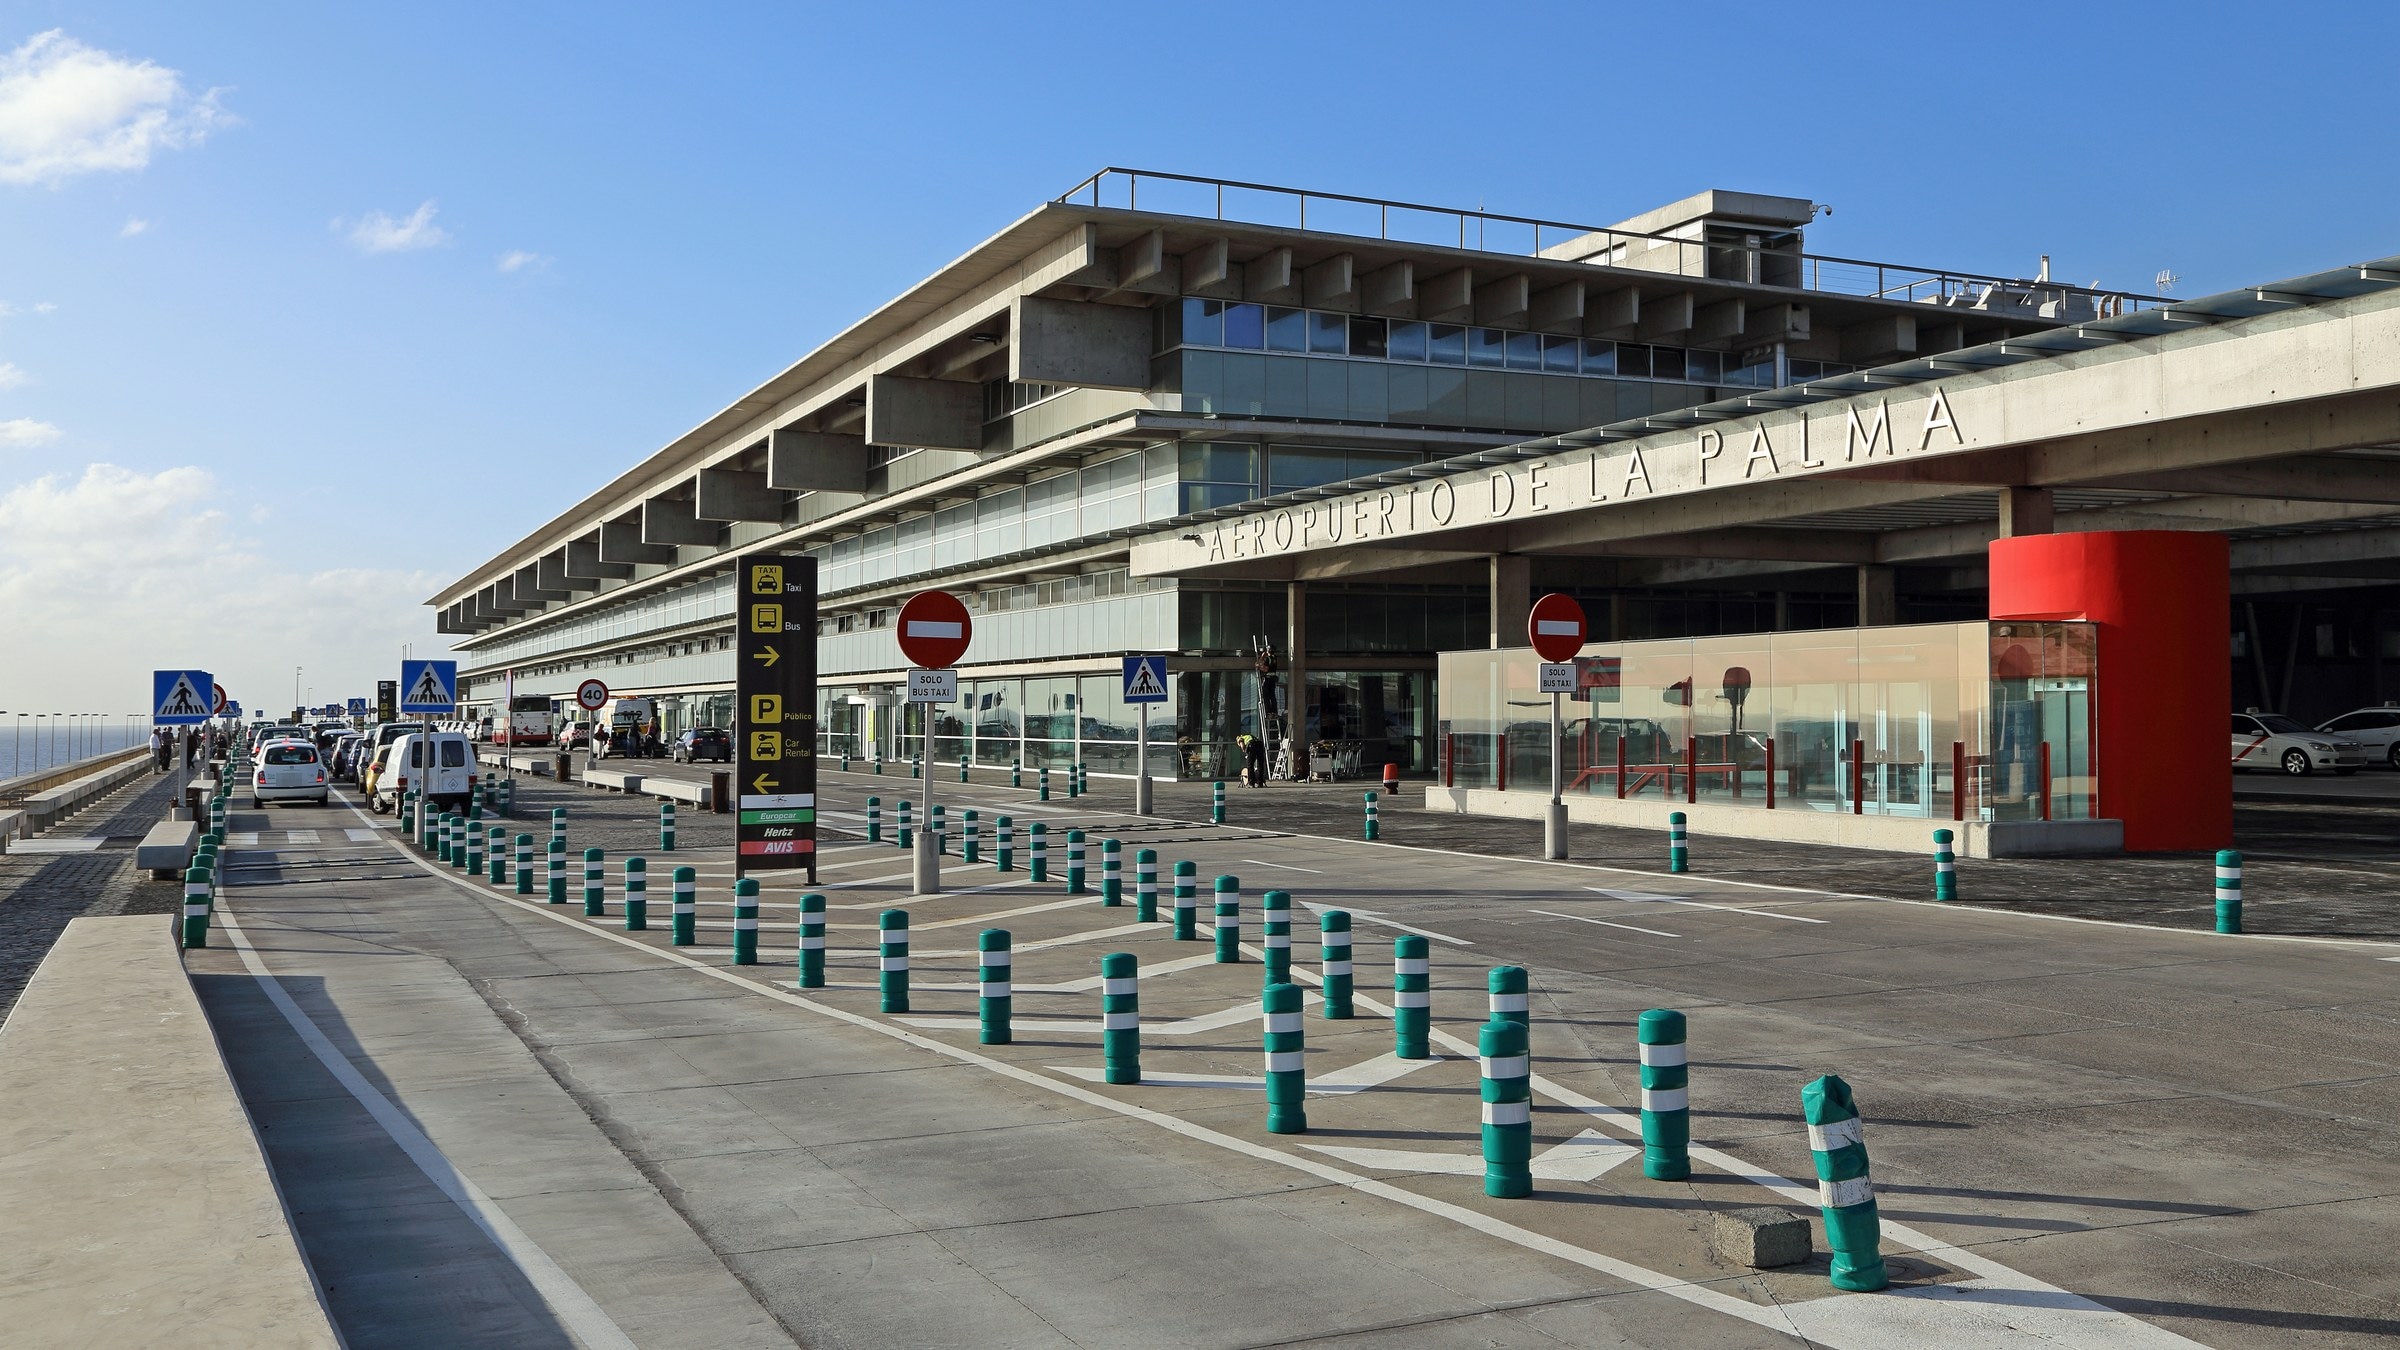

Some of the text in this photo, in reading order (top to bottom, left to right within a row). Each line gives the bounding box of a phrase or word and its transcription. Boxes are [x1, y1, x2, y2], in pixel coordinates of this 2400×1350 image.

[1210, 386, 1965, 562] AEROPUERTO DE LA PALMA
[785, 583, 802, 592] Taxi
[785, 622, 801, 631] Bus
[1549, 668, 1566, 676] SOLO
[920, 676, 943, 684] SOLO
[1543, 679, 1571, 687] BUS TAXI
[583, 690, 602, 700] 40
[912, 688, 950, 697] BUS TAXI
[758, 699, 775, 719] P
[785, 739, 799, 747] Car
[785, 748, 811, 757] Rental
[760, 812, 797, 821] Europcar
[764, 827, 794, 837] Hertz
[764, 841, 794, 853] AVIS
